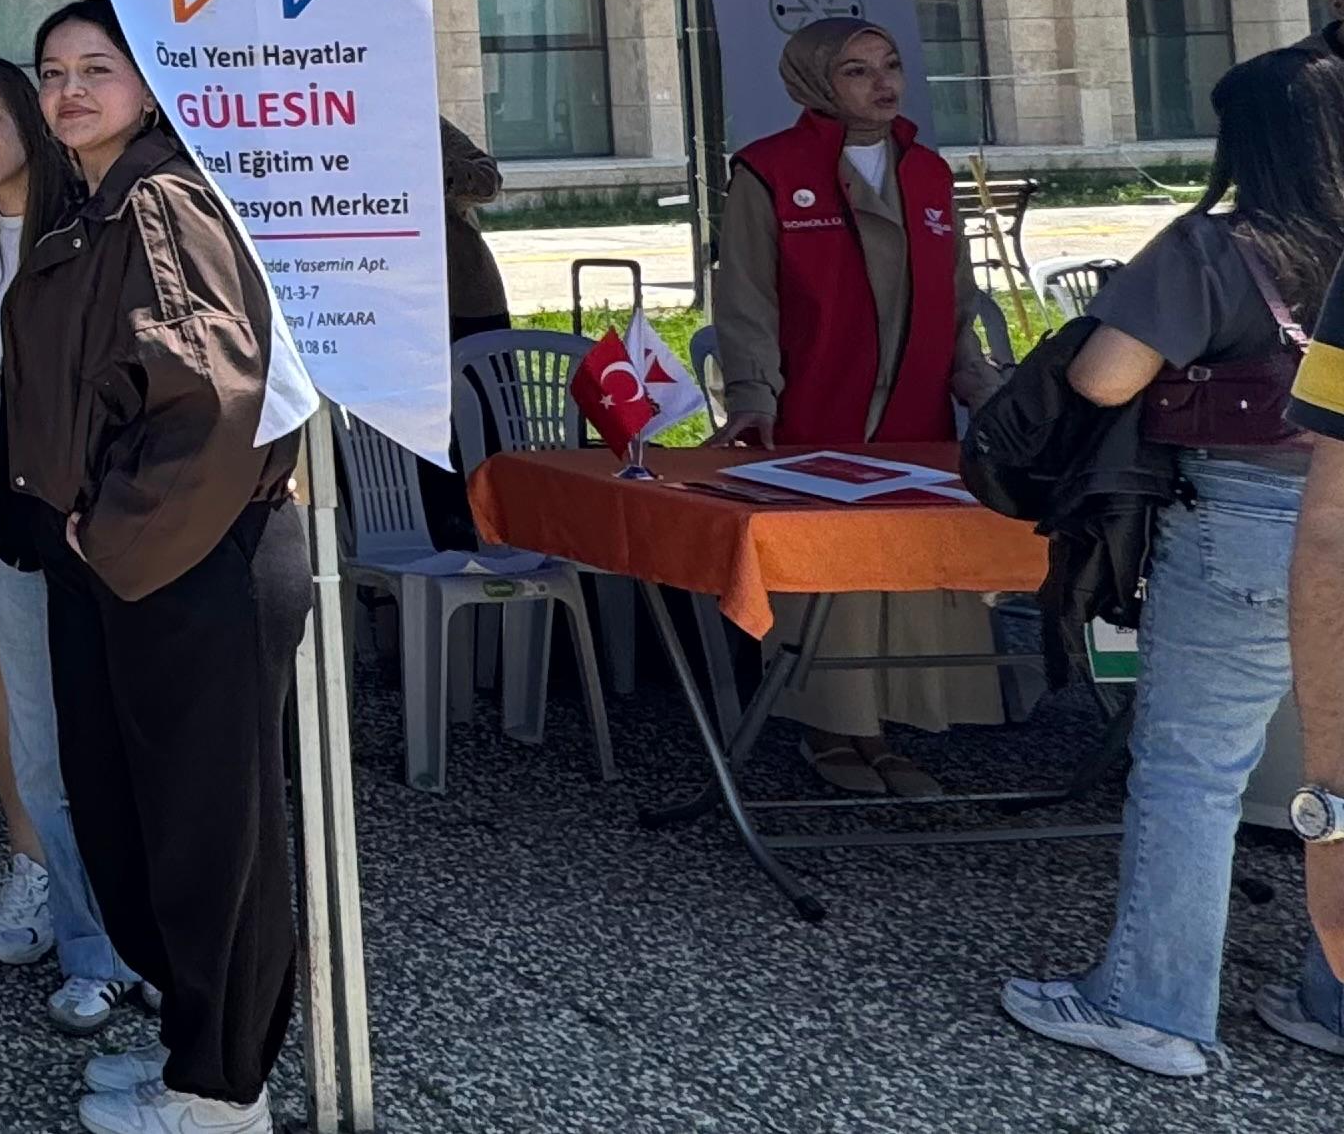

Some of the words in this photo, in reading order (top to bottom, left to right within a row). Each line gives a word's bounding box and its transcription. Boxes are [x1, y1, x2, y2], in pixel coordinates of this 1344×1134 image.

[156, 41, 197, 68] Özel
[202, 45, 255, 68] Yeni
[263, 41, 368, 70] Hayatlar
[176, 82, 356, 128] GÜLESİN
[238, 150, 314, 179] Eğitim
[320, 153, 350, 171] ve
[311, 192, 409, 217] Merkezi
[294, 258, 354, 272] Yasemin
[358, 257, 389, 274] Apt.
[317, 312, 376, 327] ANKARA
[322, 339, 338, 354] 61
